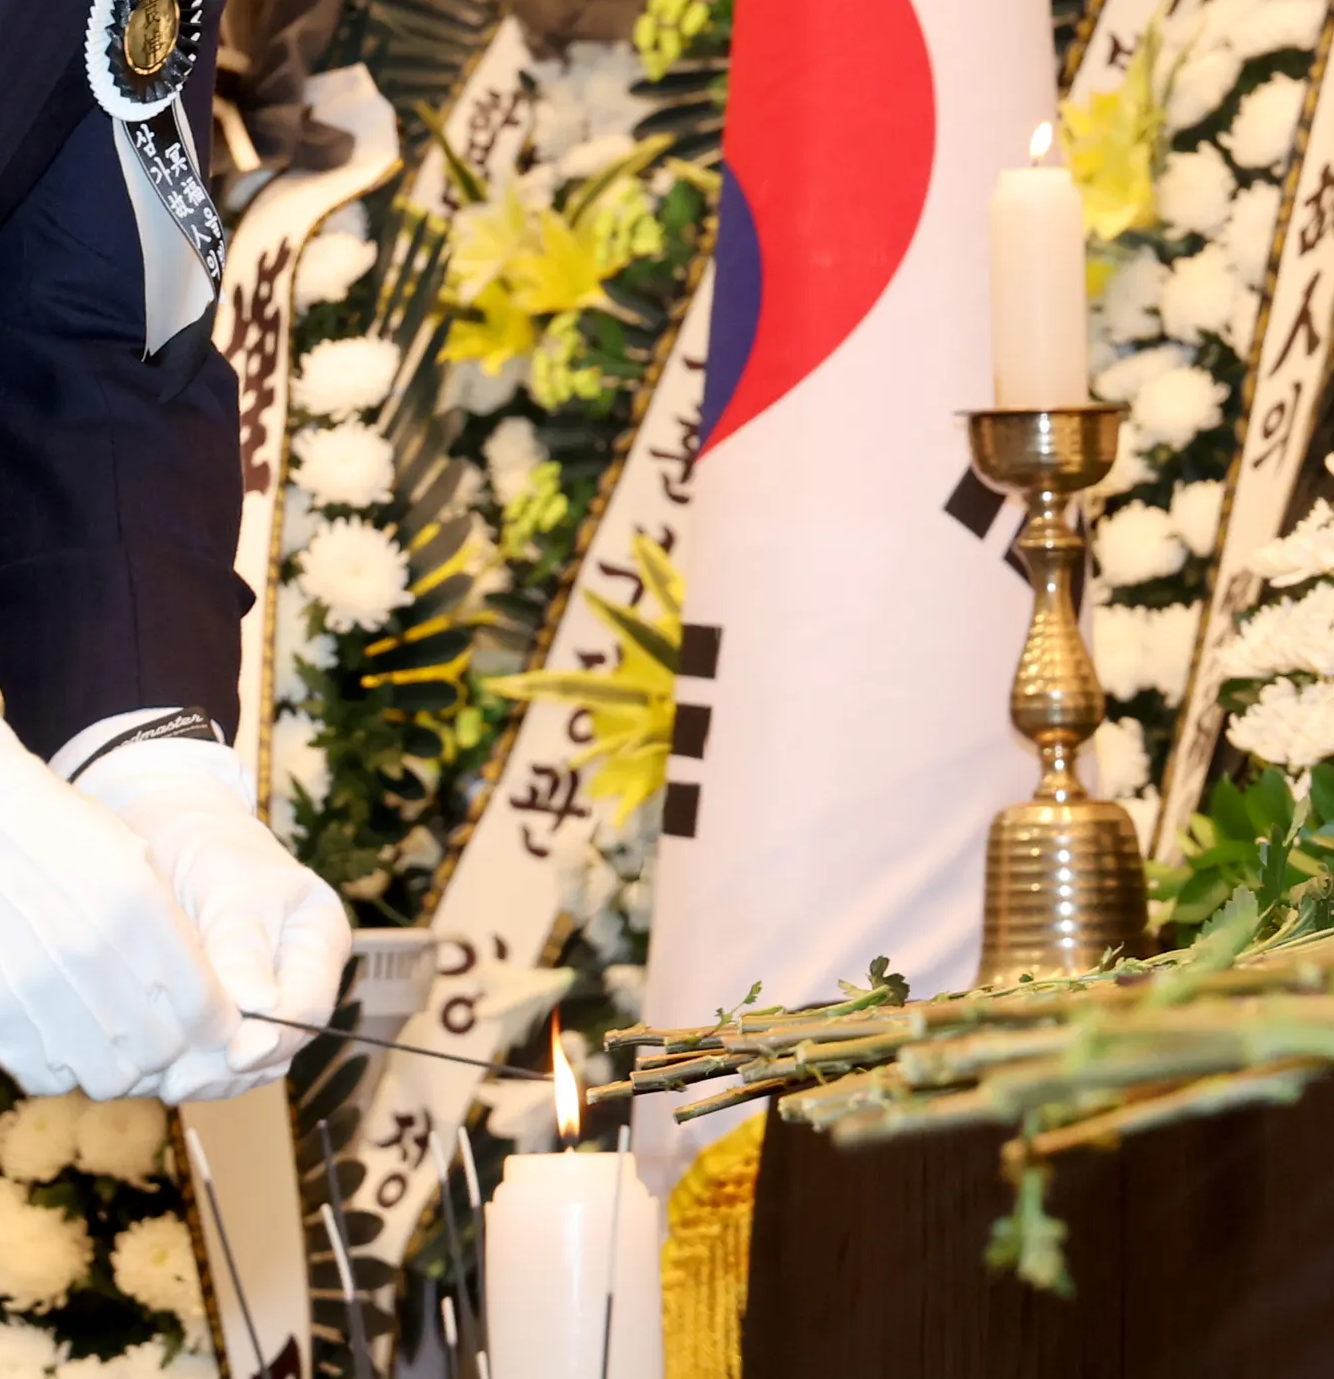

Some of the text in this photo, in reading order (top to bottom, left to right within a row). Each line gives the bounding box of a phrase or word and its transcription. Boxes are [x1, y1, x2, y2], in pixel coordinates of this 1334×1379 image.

[136, 123, 221, 281] 삼가 故人의
[164, 141, 222, 239] 冥福을
